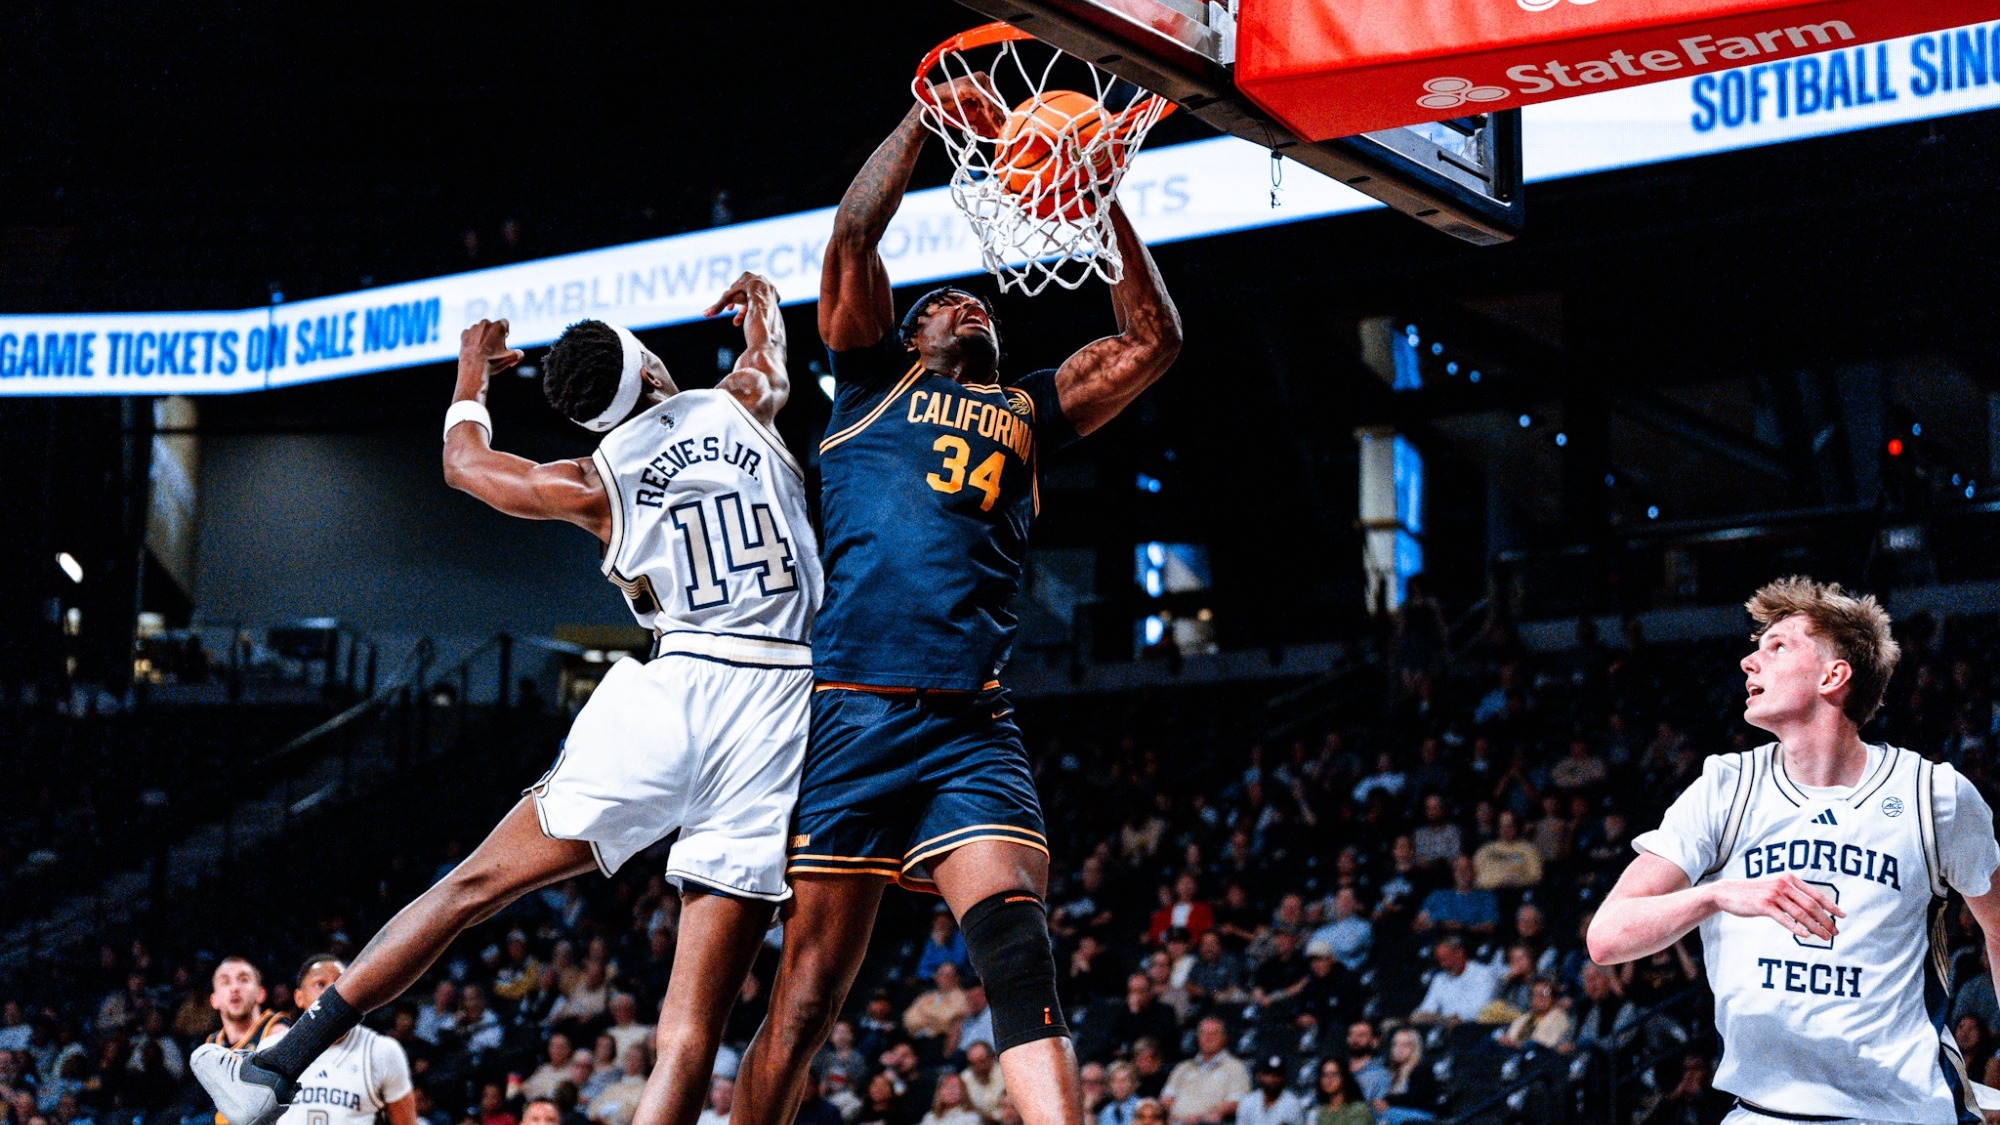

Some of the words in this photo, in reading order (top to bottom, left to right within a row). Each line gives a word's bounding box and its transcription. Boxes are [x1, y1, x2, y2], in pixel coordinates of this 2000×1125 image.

[1690, 42, 1898, 133] SOFTBALL
[0, 331, 97, 378] GAME
[106, 331, 240, 377] TICKETS
[246, 324, 288, 373] ON
[295, 309, 356, 366] SALE
[362, 296, 441, 354] NOW!
[636, 436, 720, 509] REEVES
[723, 441, 762, 481] JR.
[925, 433, 1006, 513] 34
[669, 491, 800, 612] 14
[1744, 839, 1902, 892] GEORGIA
[1757, 957, 1863, 998] TECH
[292, 1086, 362, 1112] ORGIA
